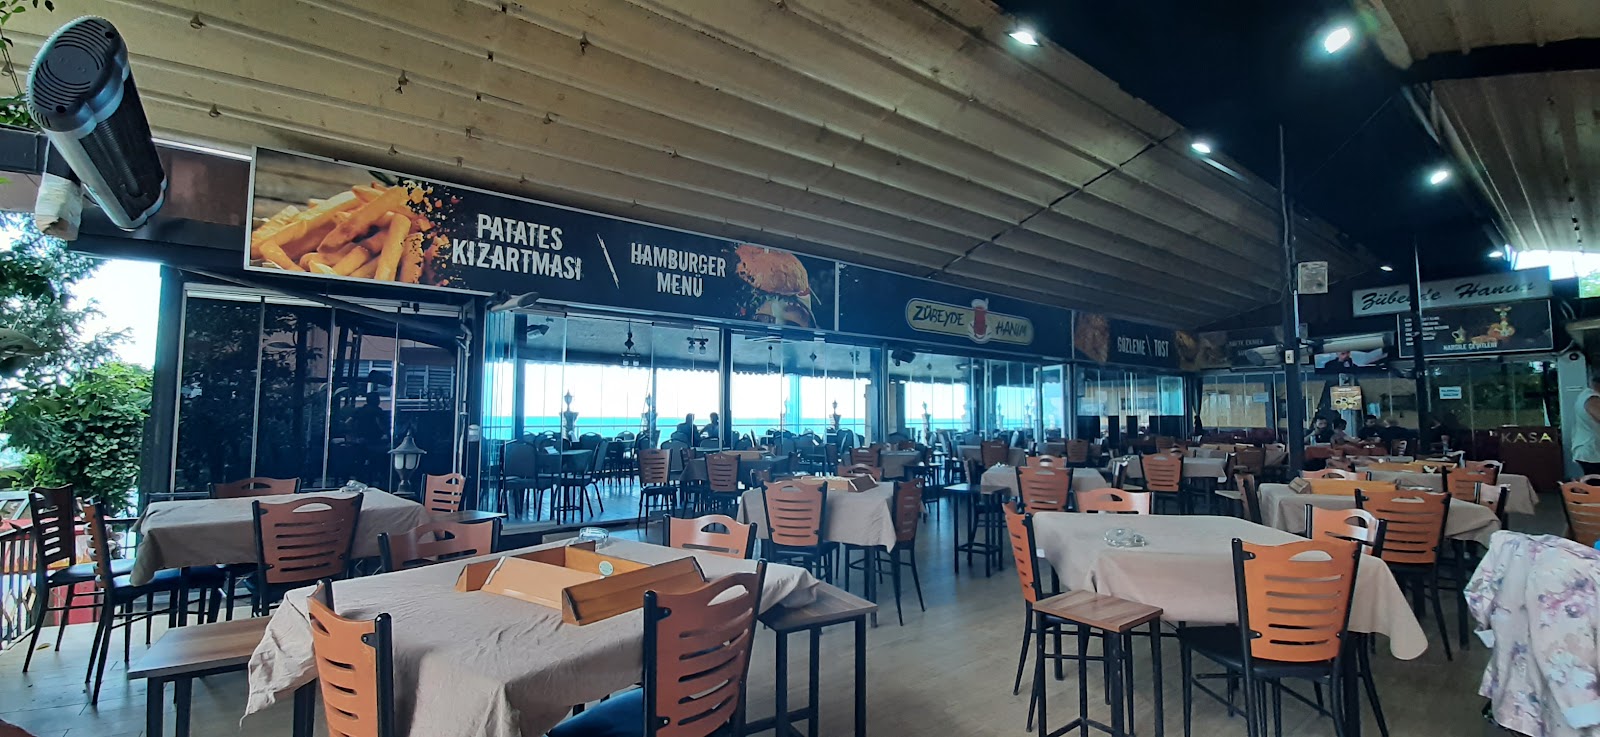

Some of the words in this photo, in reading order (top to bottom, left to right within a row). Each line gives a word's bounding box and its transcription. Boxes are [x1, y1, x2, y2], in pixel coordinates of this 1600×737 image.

[477, 213, 563, 251] PATATES
[452, 238, 582, 281] KIZARTMASI
[631, 242, 726, 278] HAMBURGER
[657, 272, 704, 298] MENÜ
[1362, 288, 1441, 310] Zübede
[913, 304, 965, 326] ZÜBEYDE
[995, 322, 1028, 337] HANIM
[1117, 335, 1146, 355] GÖZLEME
[1153, 338, 1170, 358] TOST
[1501, 432, 1552, 443] KASA
